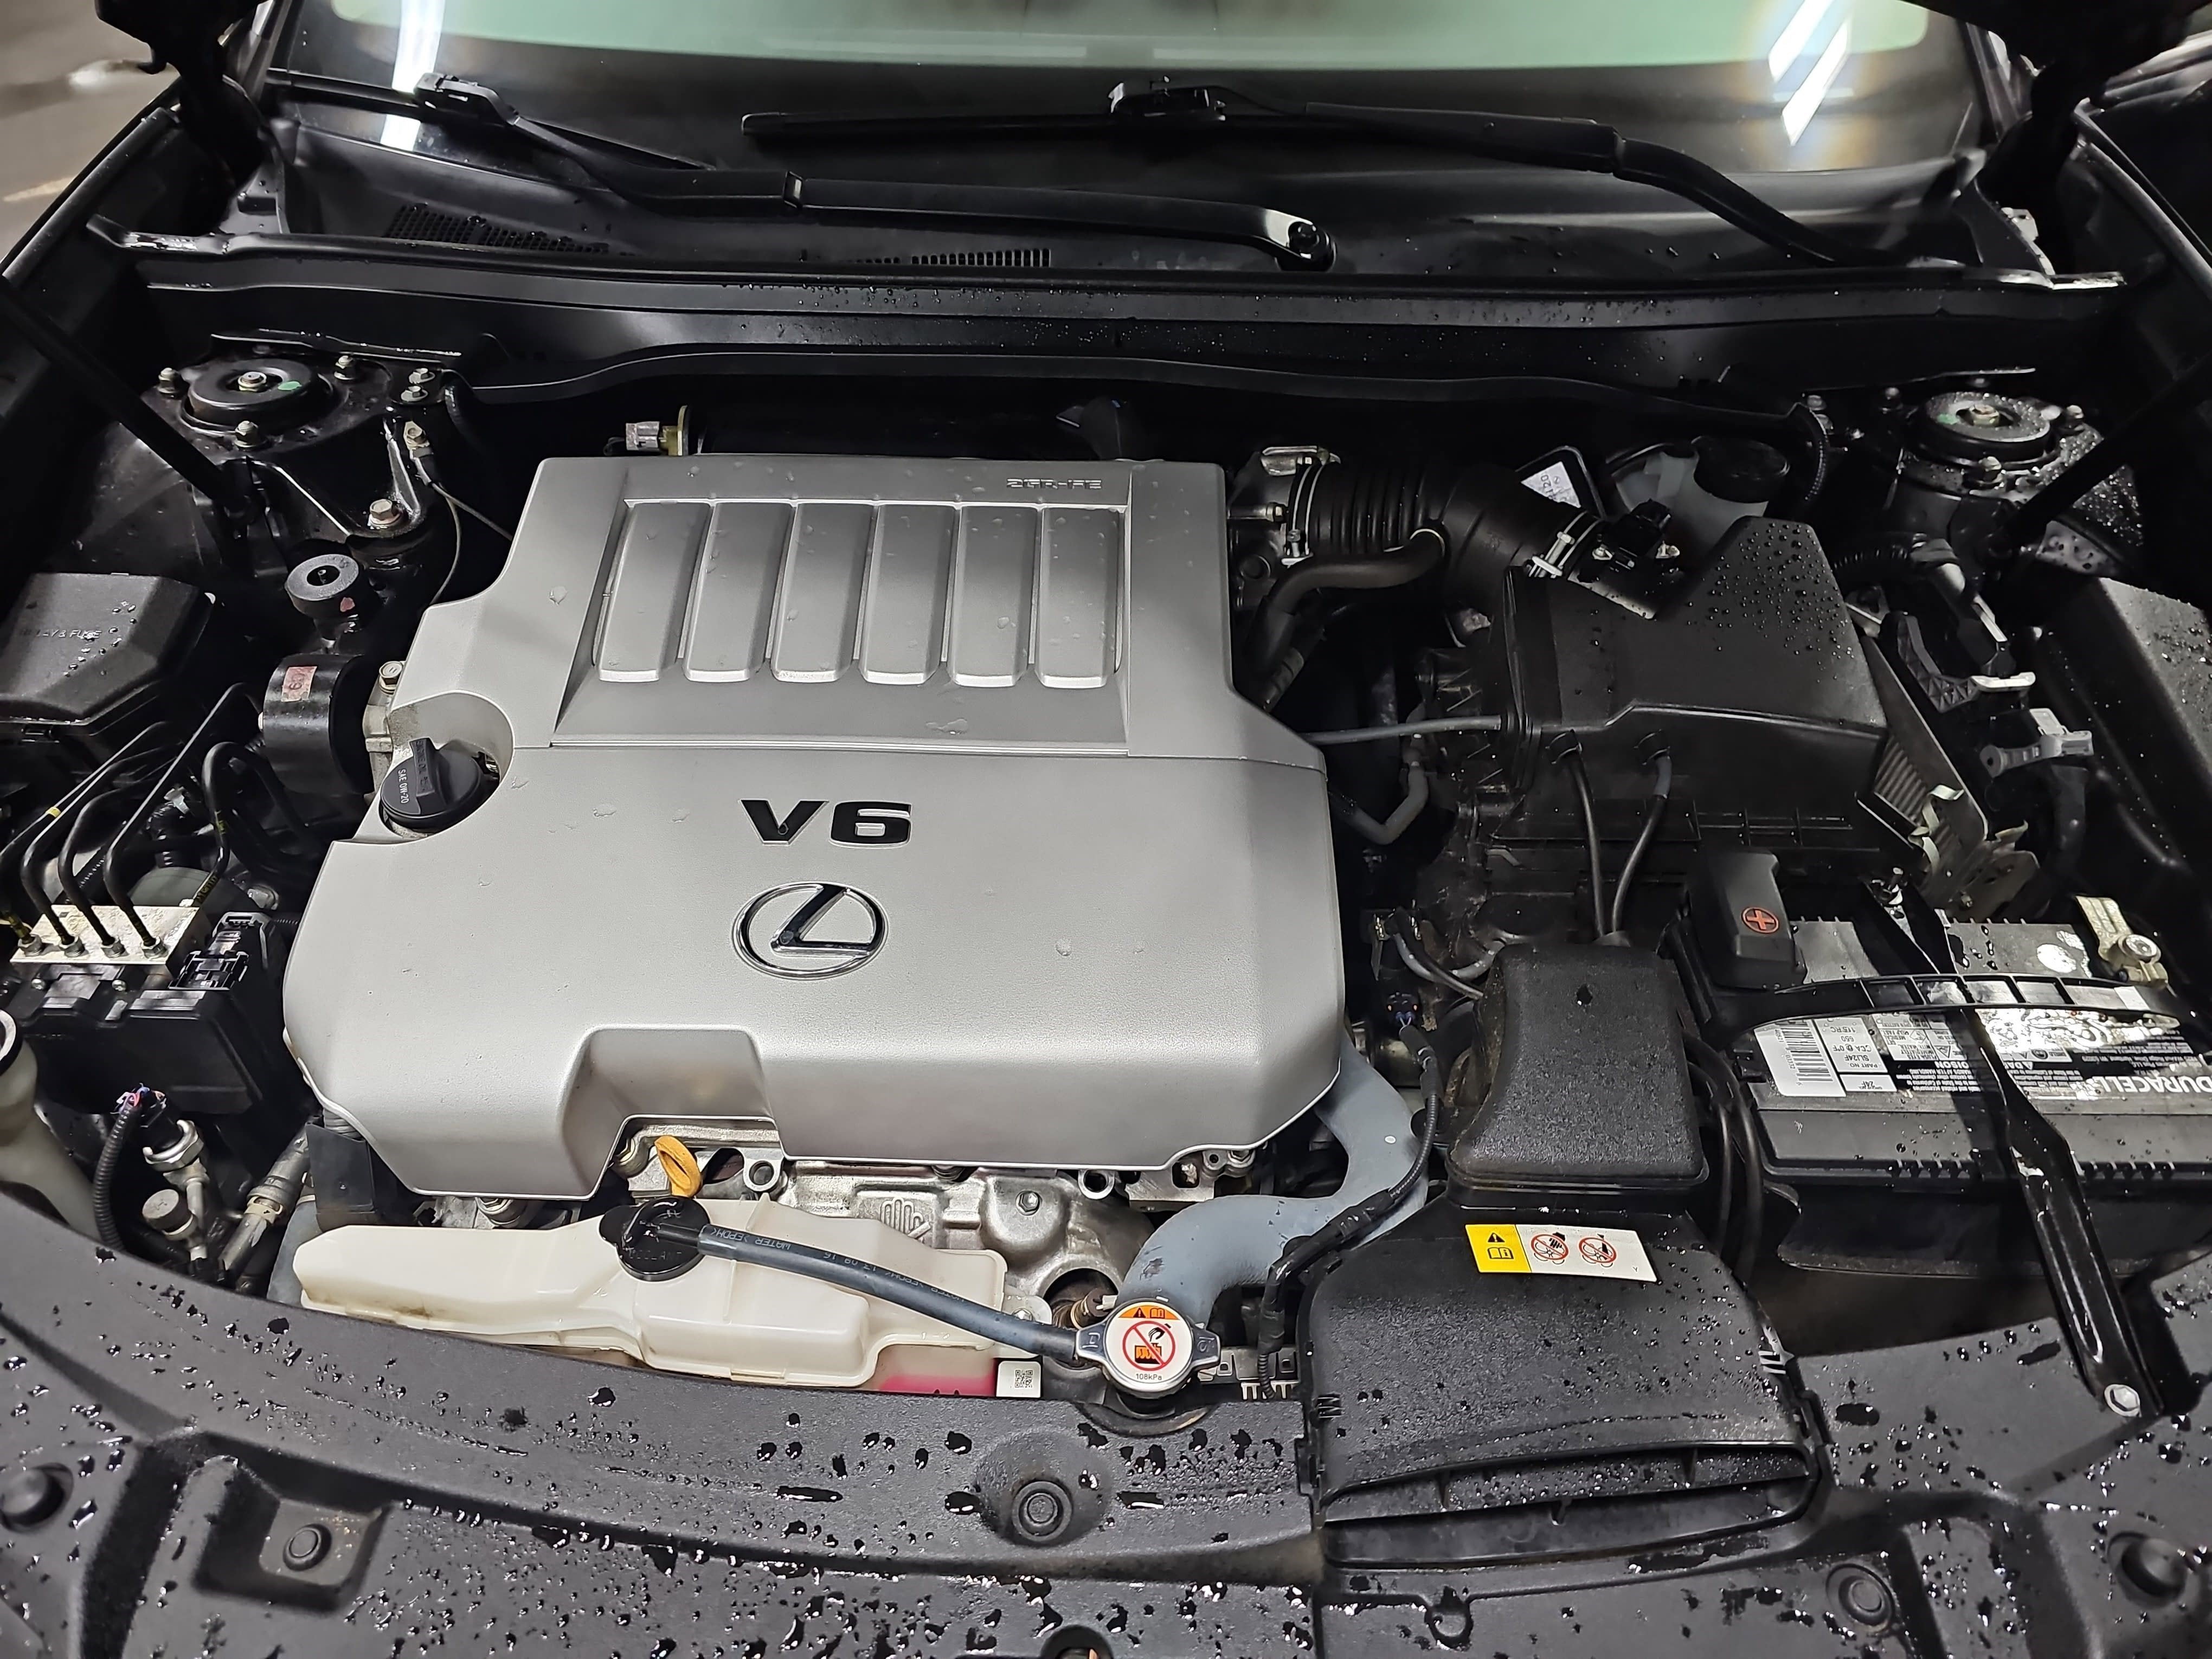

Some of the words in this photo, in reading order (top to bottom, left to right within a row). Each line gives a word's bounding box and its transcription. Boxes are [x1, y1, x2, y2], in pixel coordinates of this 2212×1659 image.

[398, 769, 407, 782] SAE
[400, 782, 410, 803] 0W-20
[740, 798, 913, 848] V6
[2093, 1076, 2212, 1093] DURACELL
[755, 1237, 792, 1250] WATER
[1136, 1373, 1162, 1381] 108kPa
